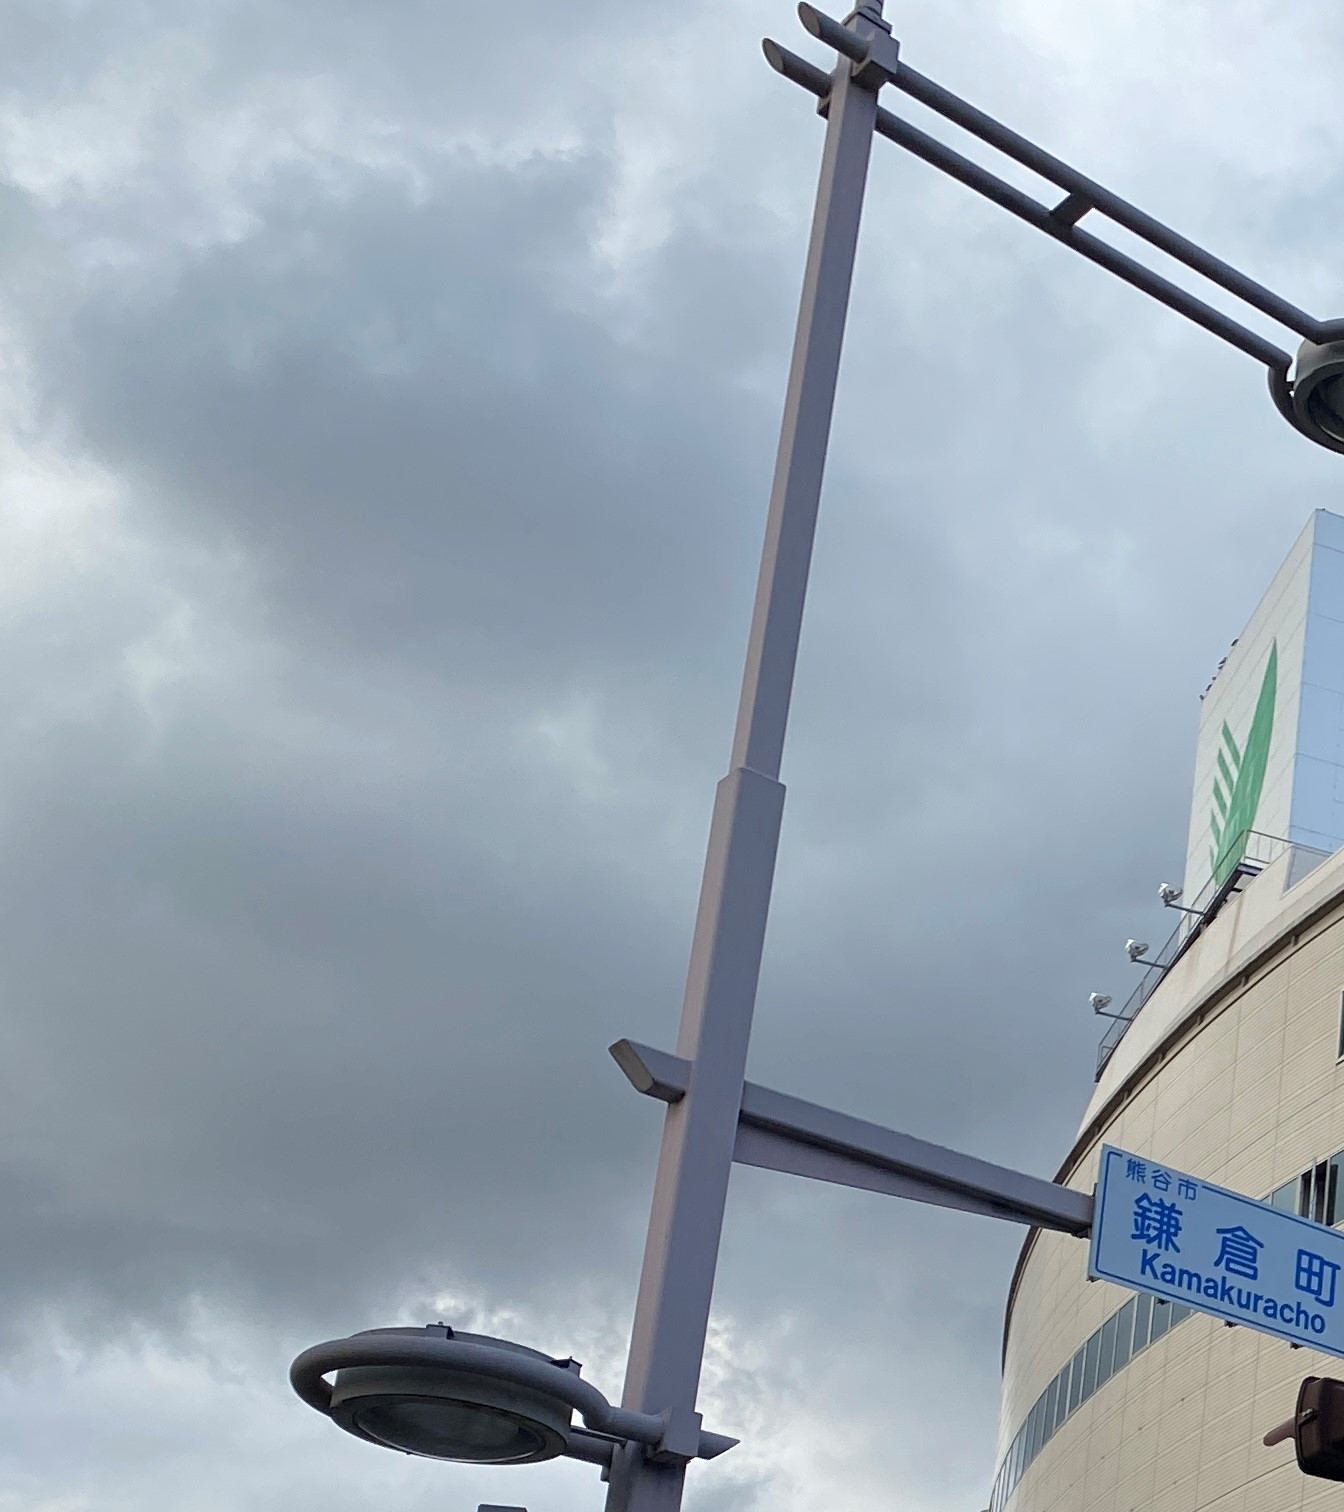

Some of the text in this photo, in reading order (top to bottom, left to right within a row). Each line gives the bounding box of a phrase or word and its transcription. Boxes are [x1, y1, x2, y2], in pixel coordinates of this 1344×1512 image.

[1125, 1157, 1199, 1201] 熊谷市
[1131, 1192, 1341, 1308] 鎌倉町
[1140, 1248, 1327, 1334] Kamakuracho
